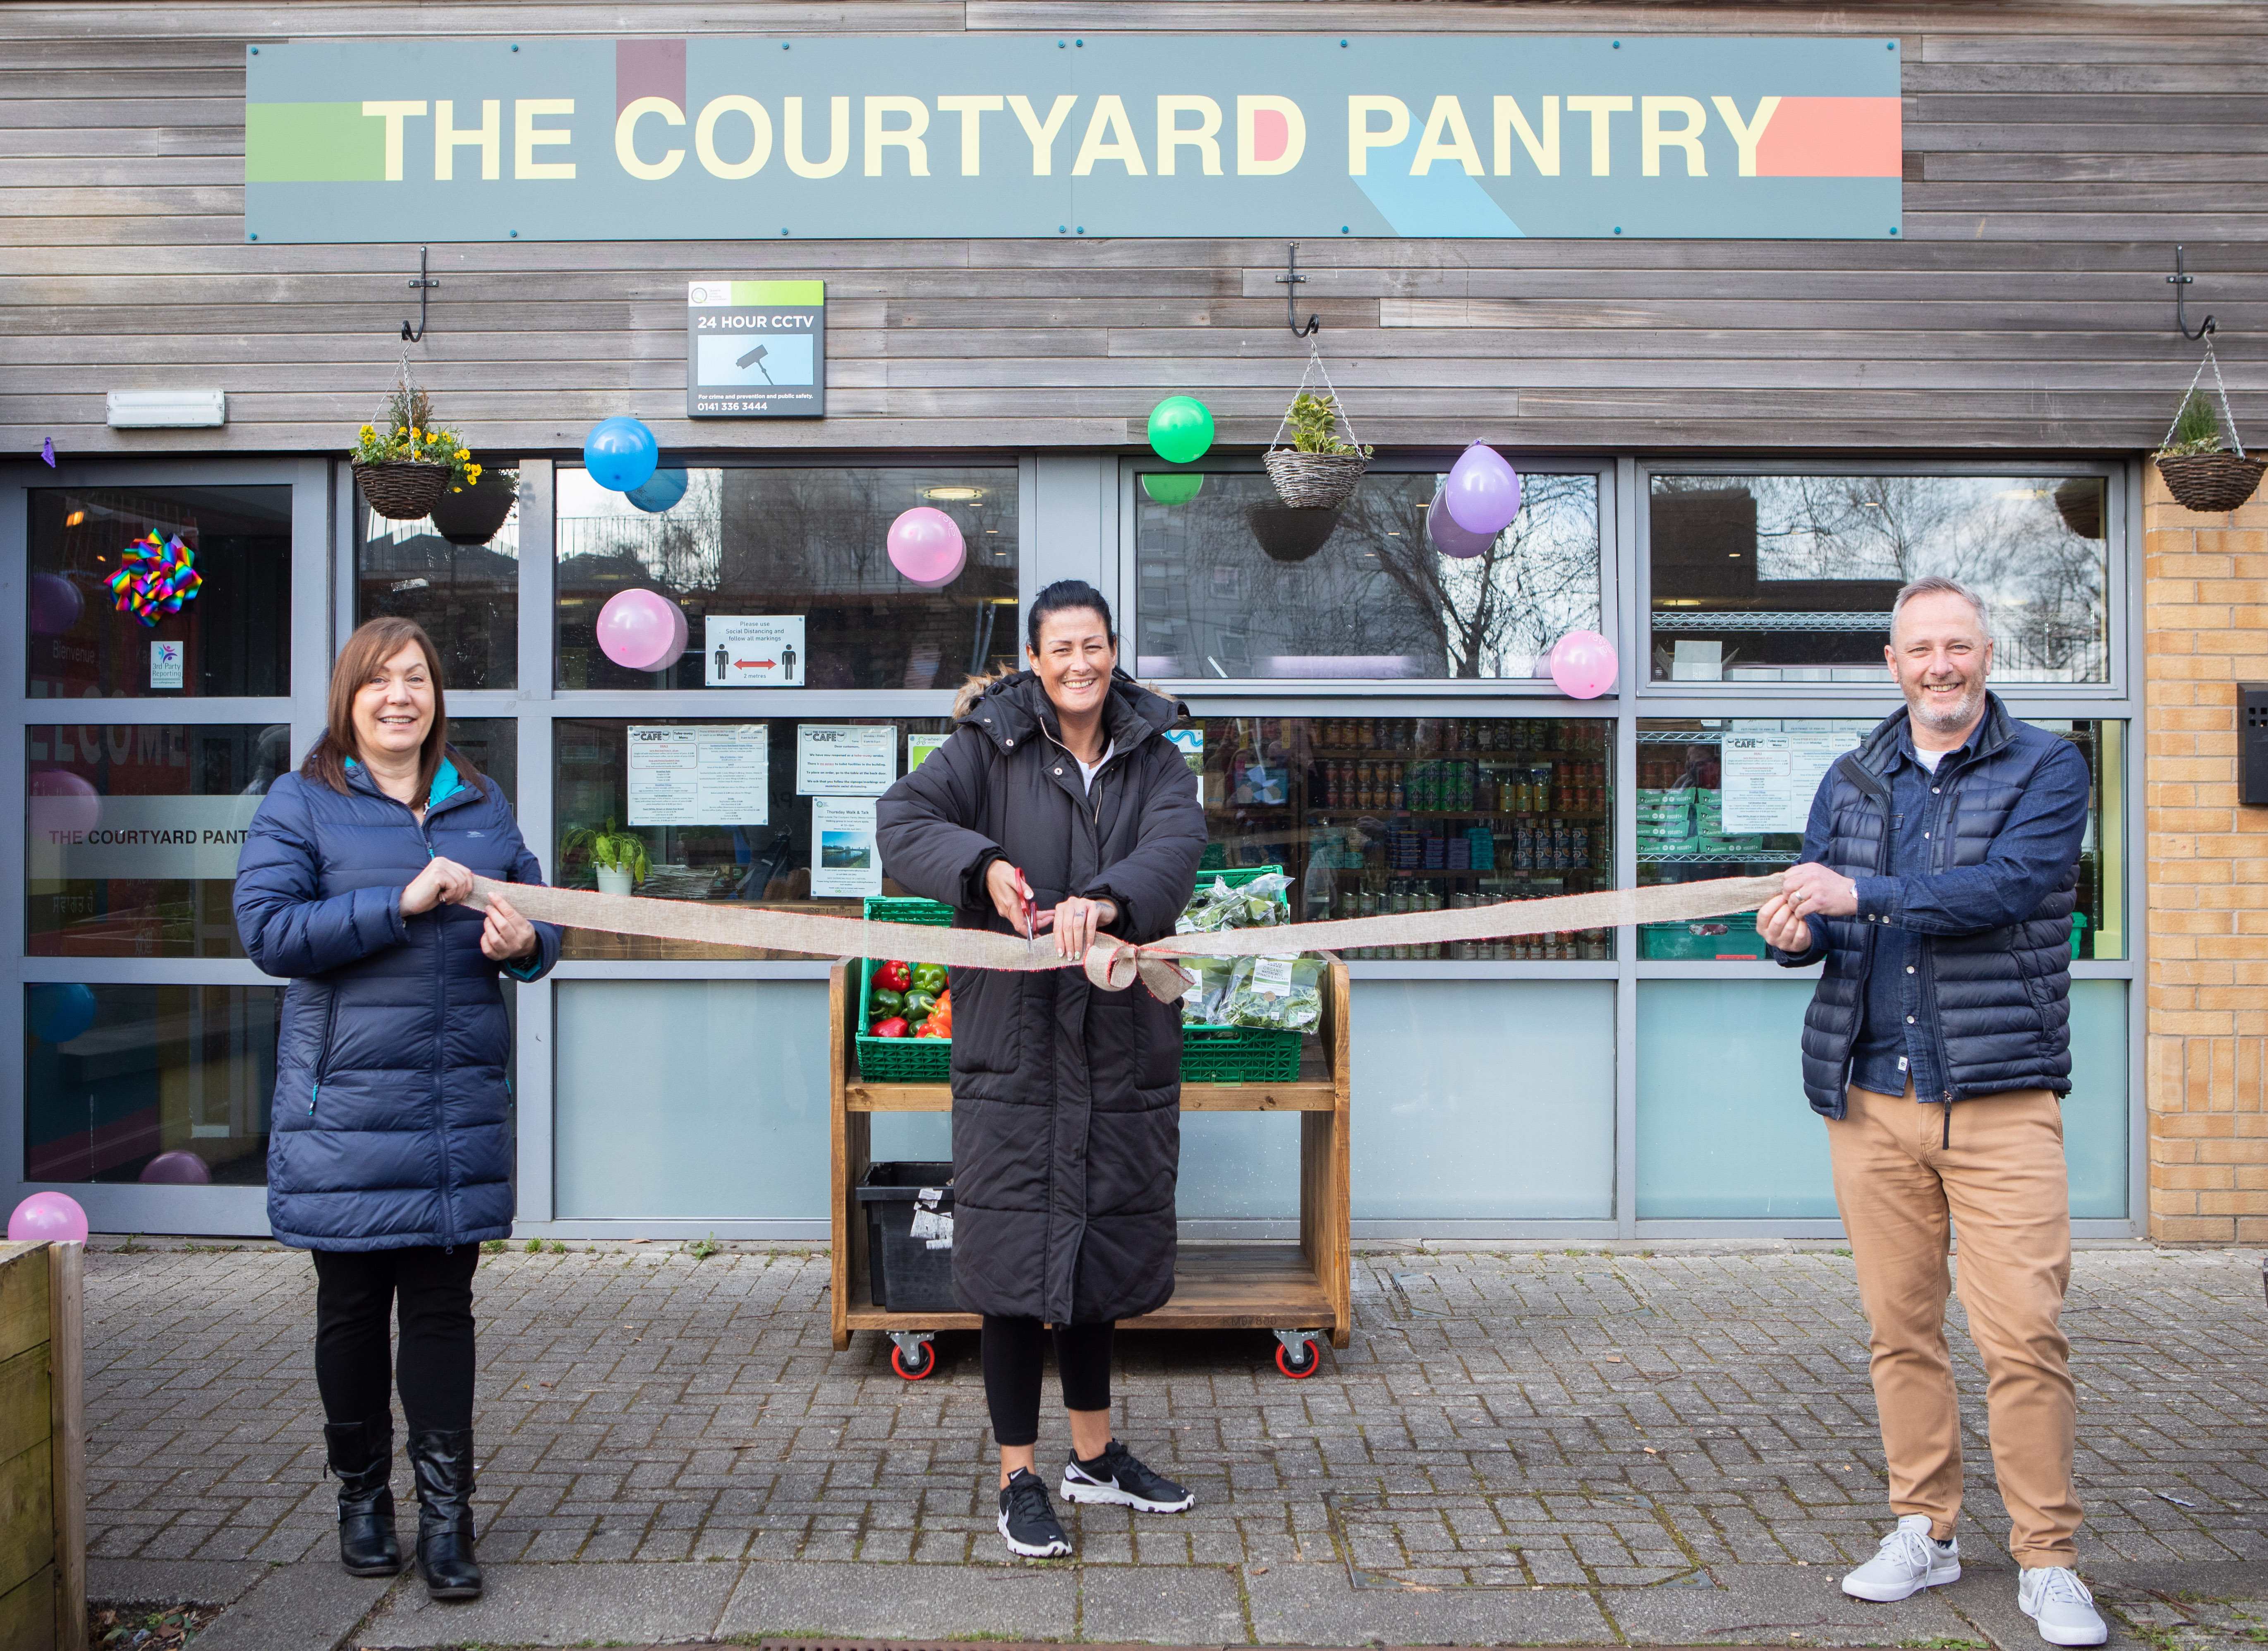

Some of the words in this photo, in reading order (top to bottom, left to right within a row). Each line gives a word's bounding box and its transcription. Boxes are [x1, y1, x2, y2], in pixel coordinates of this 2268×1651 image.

[362, 99, 577, 181] THE
[615, 94, 1307, 180] COURTYARD
[1348, 95, 1782, 177] PANTRY
[698, 316, 717, 328] 24
[722, 316, 767, 328] HOUR
[771, 315, 814, 328] CCTV
[53, 641, 95, 664] Bienvenue
[49, 831, 82, 845] THE
[89, 830, 197, 845] COURTYARD
[203, 830, 248, 844] PANT
